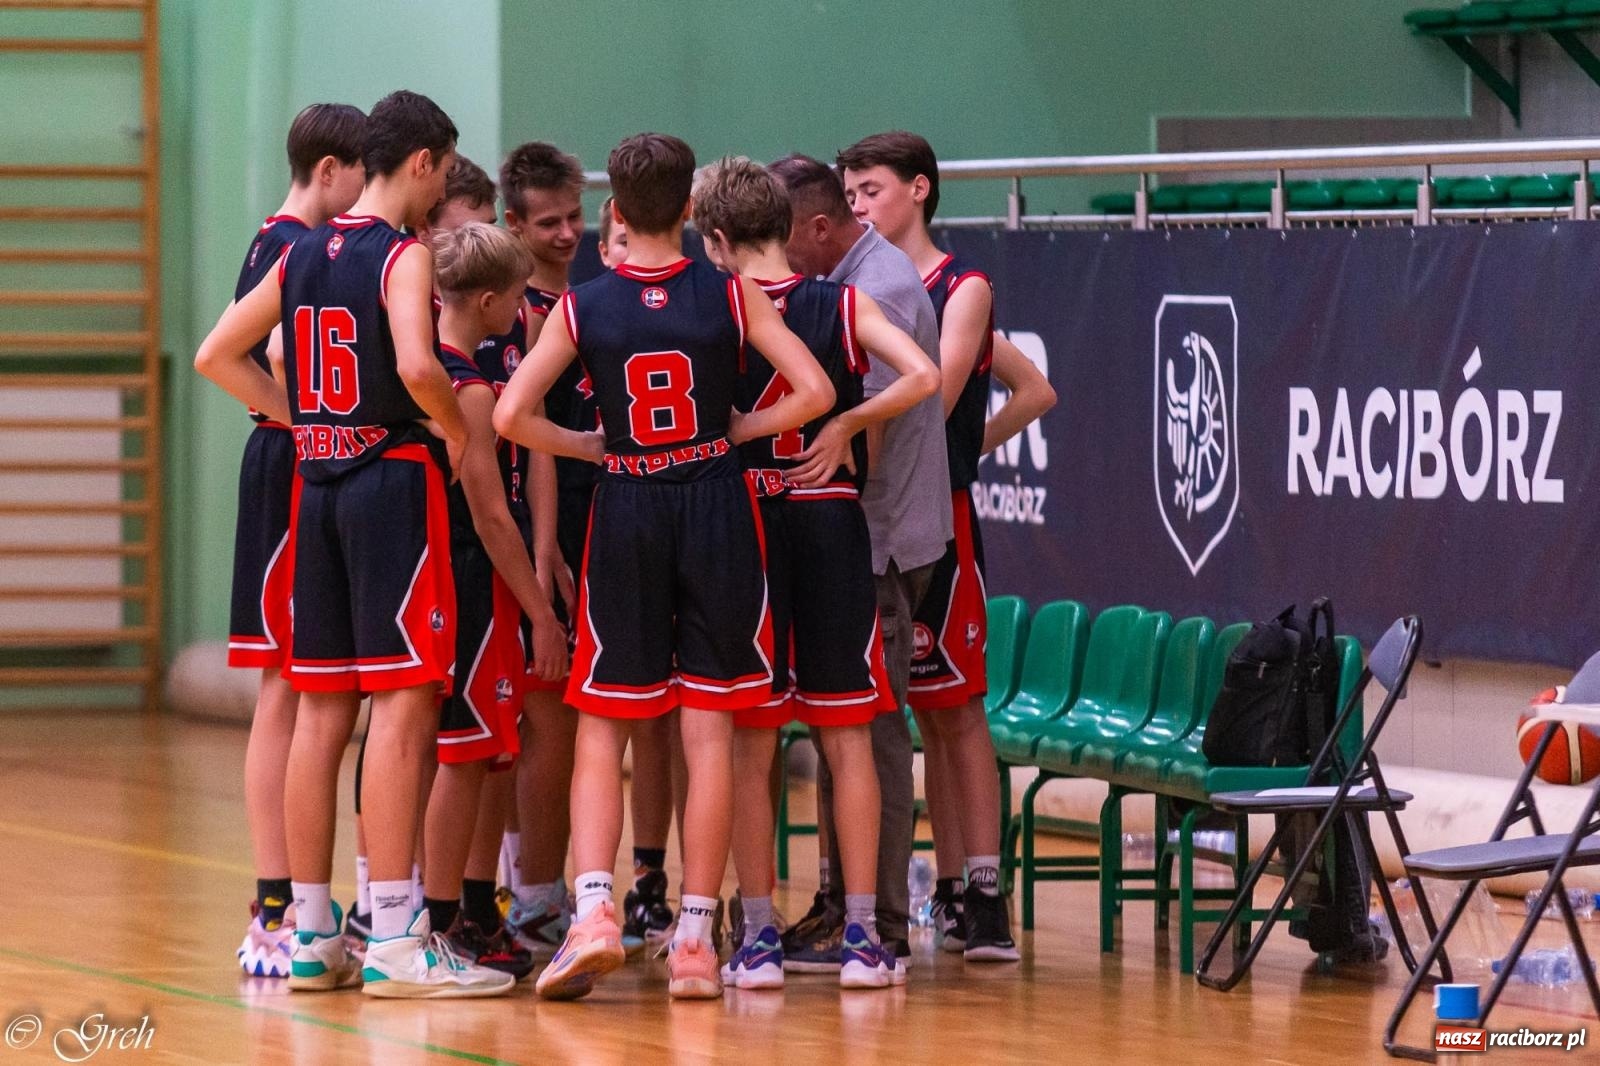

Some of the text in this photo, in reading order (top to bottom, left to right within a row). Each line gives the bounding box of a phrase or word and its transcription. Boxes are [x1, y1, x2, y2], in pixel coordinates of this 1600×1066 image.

[294, 305, 360, 415] 16
[623, 350, 699, 447] 8
[1286, 346, 1565, 504] RACIBÓRZ
[971, 472, 1047, 525] RACIBÓRZ
